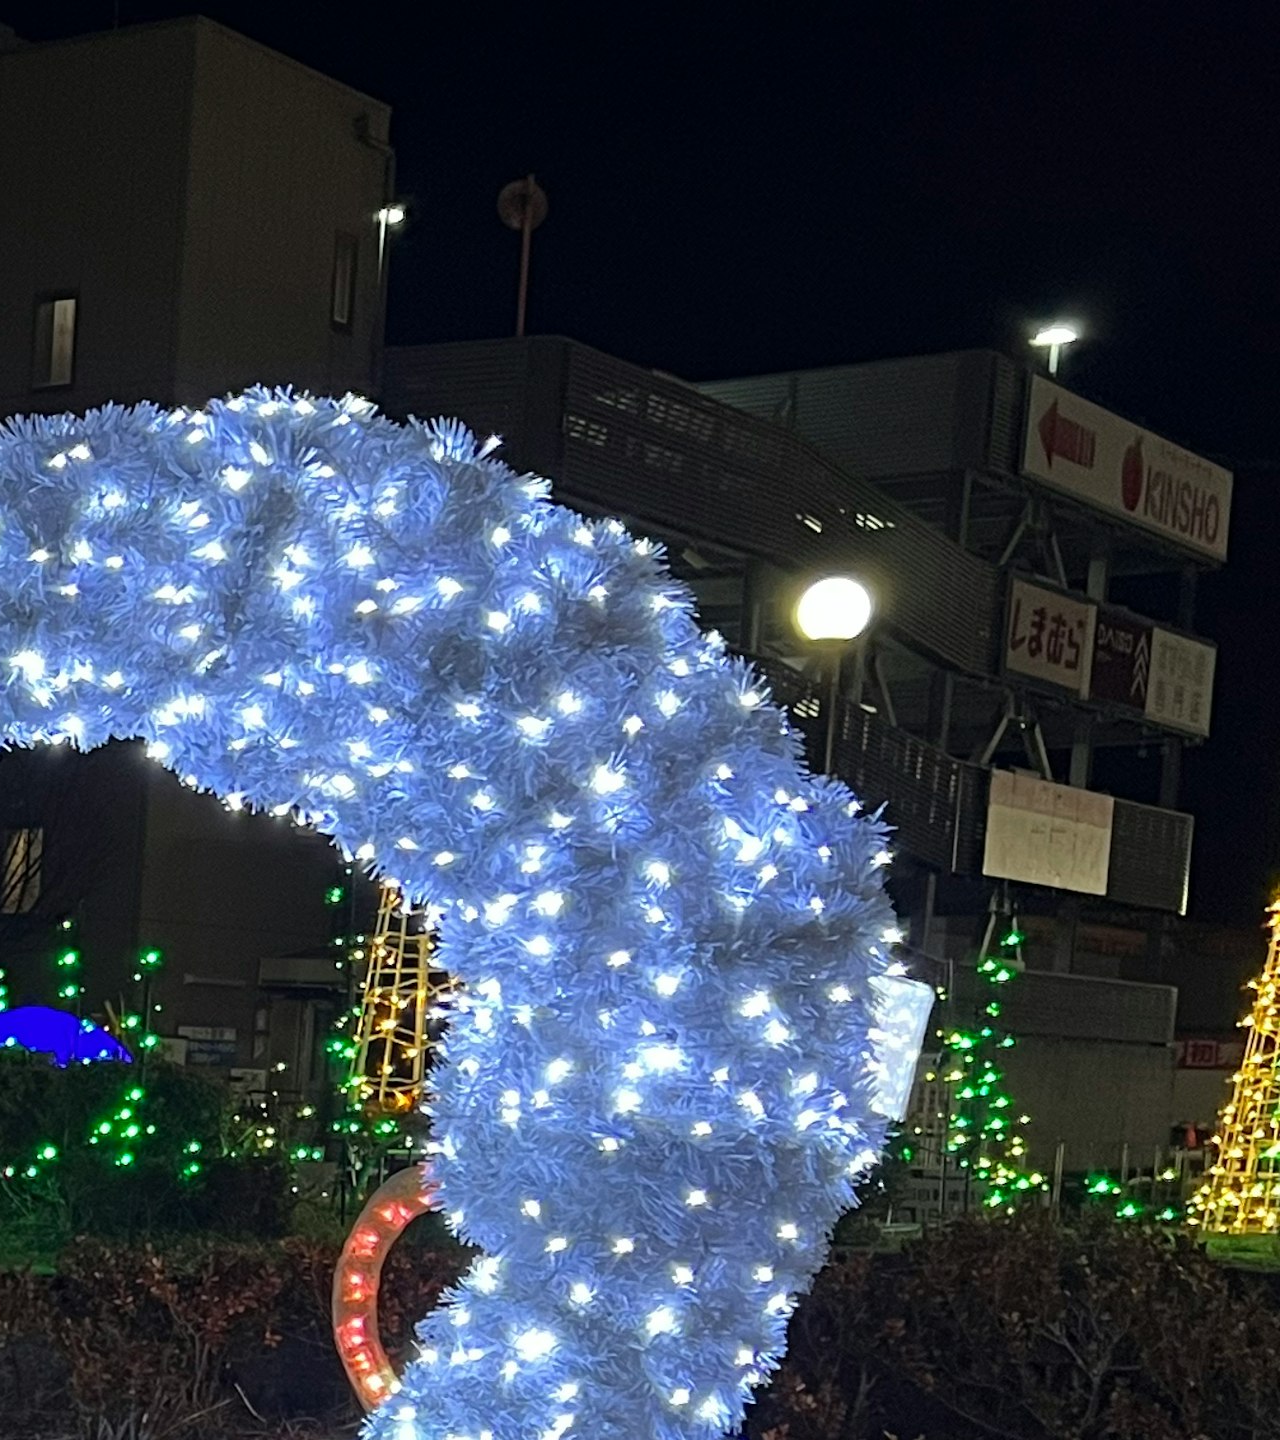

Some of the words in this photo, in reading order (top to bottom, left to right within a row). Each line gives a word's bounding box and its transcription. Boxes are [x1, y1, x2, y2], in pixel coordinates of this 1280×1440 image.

[1144, 464, 1219, 545] KINSHO
[1010, 598, 1084, 671] しまむら
